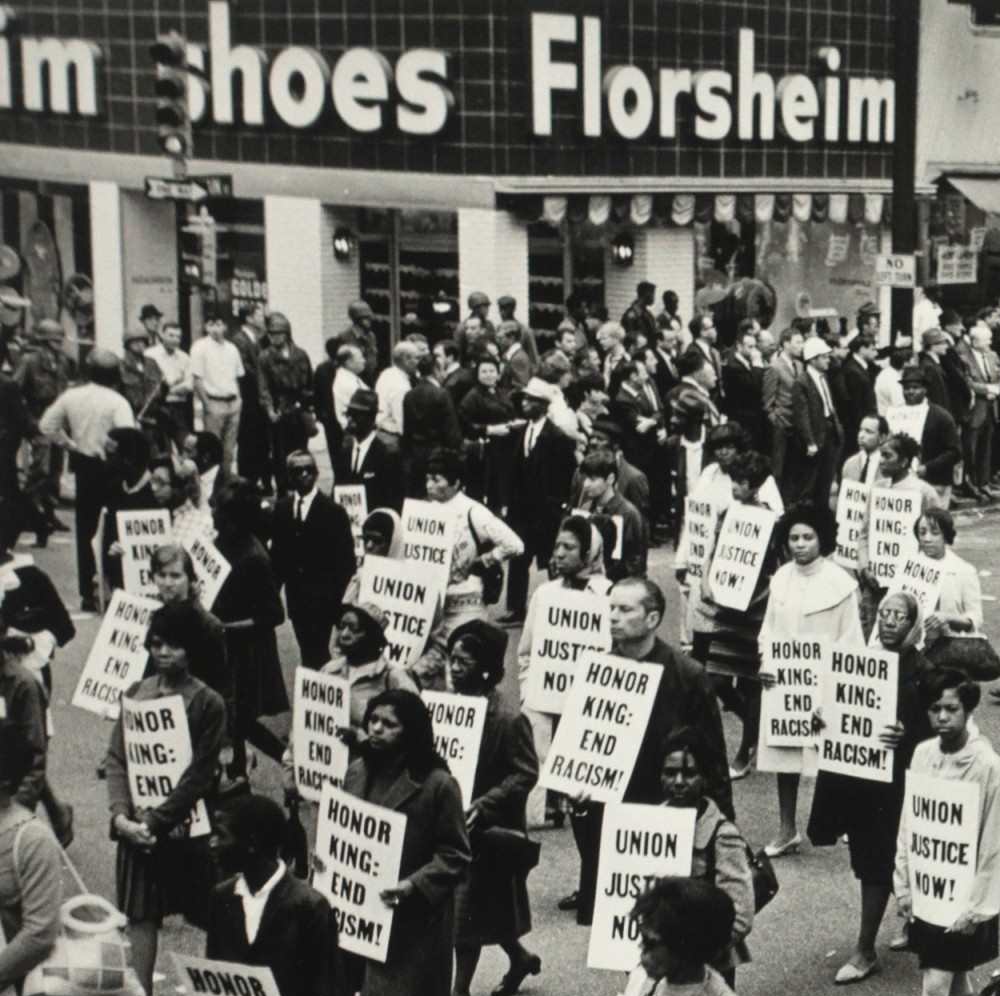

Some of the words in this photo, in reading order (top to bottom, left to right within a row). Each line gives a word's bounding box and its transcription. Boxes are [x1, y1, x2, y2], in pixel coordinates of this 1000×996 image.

[531, 13, 895, 142] Florsheim
[886, 258, 904, 270] NO
[125, 517, 165, 536] HONOR
[407, 515, 446, 536] UNION
[190, 539, 222, 580] HONOR
[404, 542, 448, 566] USTICE
[877, 541, 901, 559] END
[372, 574, 427, 605] UNION
[547, 606, 602, 633] UNION
[771, 641, 821, 660] HONOR
[831, 650, 889, 681] HONOR
[104, 656, 130, 680] END
[586, 661, 649, 697] HONOR
[777, 668, 818, 687] KING:
[302, 678, 344, 708] HONOR
[784, 694, 812, 713] END
[835, 682, 882, 711] KING:
[304, 709, 340, 739] KING:
[582, 695, 634, 727] KING:
[841, 713, 873, 739] END
[308, 740, 333, 766] END
[434, 735, 465, 760] ING:
[579, 728, 617, 757] END
[822, 738, 888, 771] RACISM!
[136, 775, 173, 797] END
[549, 754, 624, 792] RACISM!
[328, 798, 392, 845] HONOR
[912, 794, 963, 827] UNION
[329, 833, 380, 877] KING:
[615, 828, 678, 859] UNION
[910, 831, 969, 866] JUSTICE
[330, 876, 367, 907] END
[914, 870, 955, 902] NOW!
